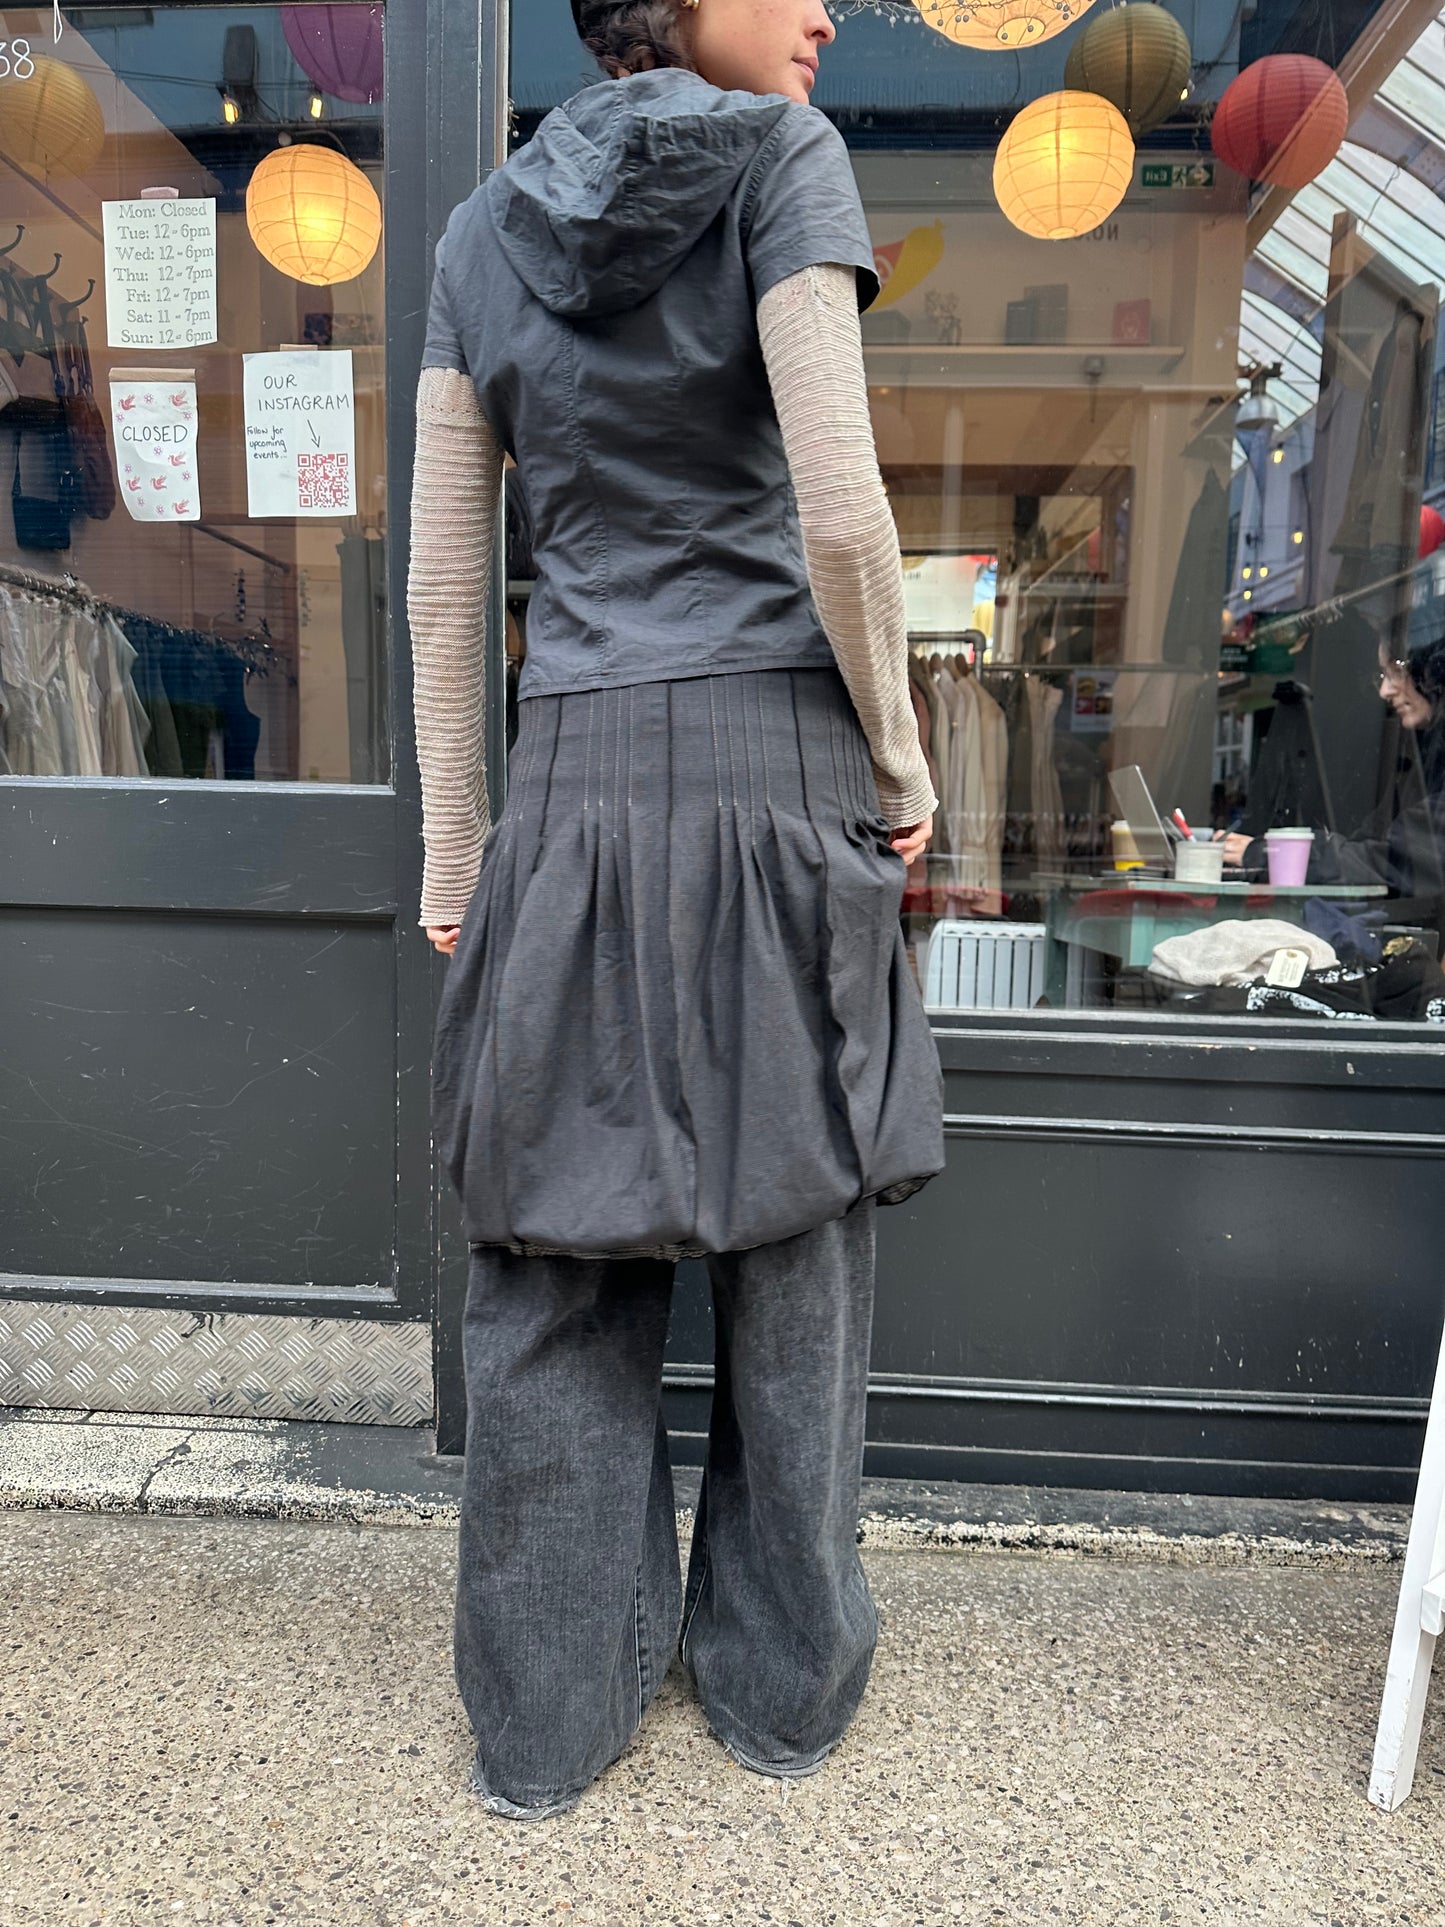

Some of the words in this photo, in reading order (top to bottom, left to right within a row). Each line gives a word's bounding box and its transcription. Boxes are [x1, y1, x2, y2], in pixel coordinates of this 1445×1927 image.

[119, 204, 156, 219] Mon:
[160, 202, 207, 217] Closed
[117, 226, 149, 240] Tue:
[115, 246, 154, 260] Wed:
[113, 267, 149, 281] Thu:
[126, 288, 151, 302] Fri:
[127, 309, 152, 323] Sat:
[121, 329, 153, 343] Sun:
[263, 373, 298, 390] OUR
[258, 393, 350, 411] INSTAGRAM
[122, 424, 188, 443] CLOSED
[246, 425, 269, 436] Follow
[271, 424, 284, 441] for
[249, 439, 288, 453] upcoming
